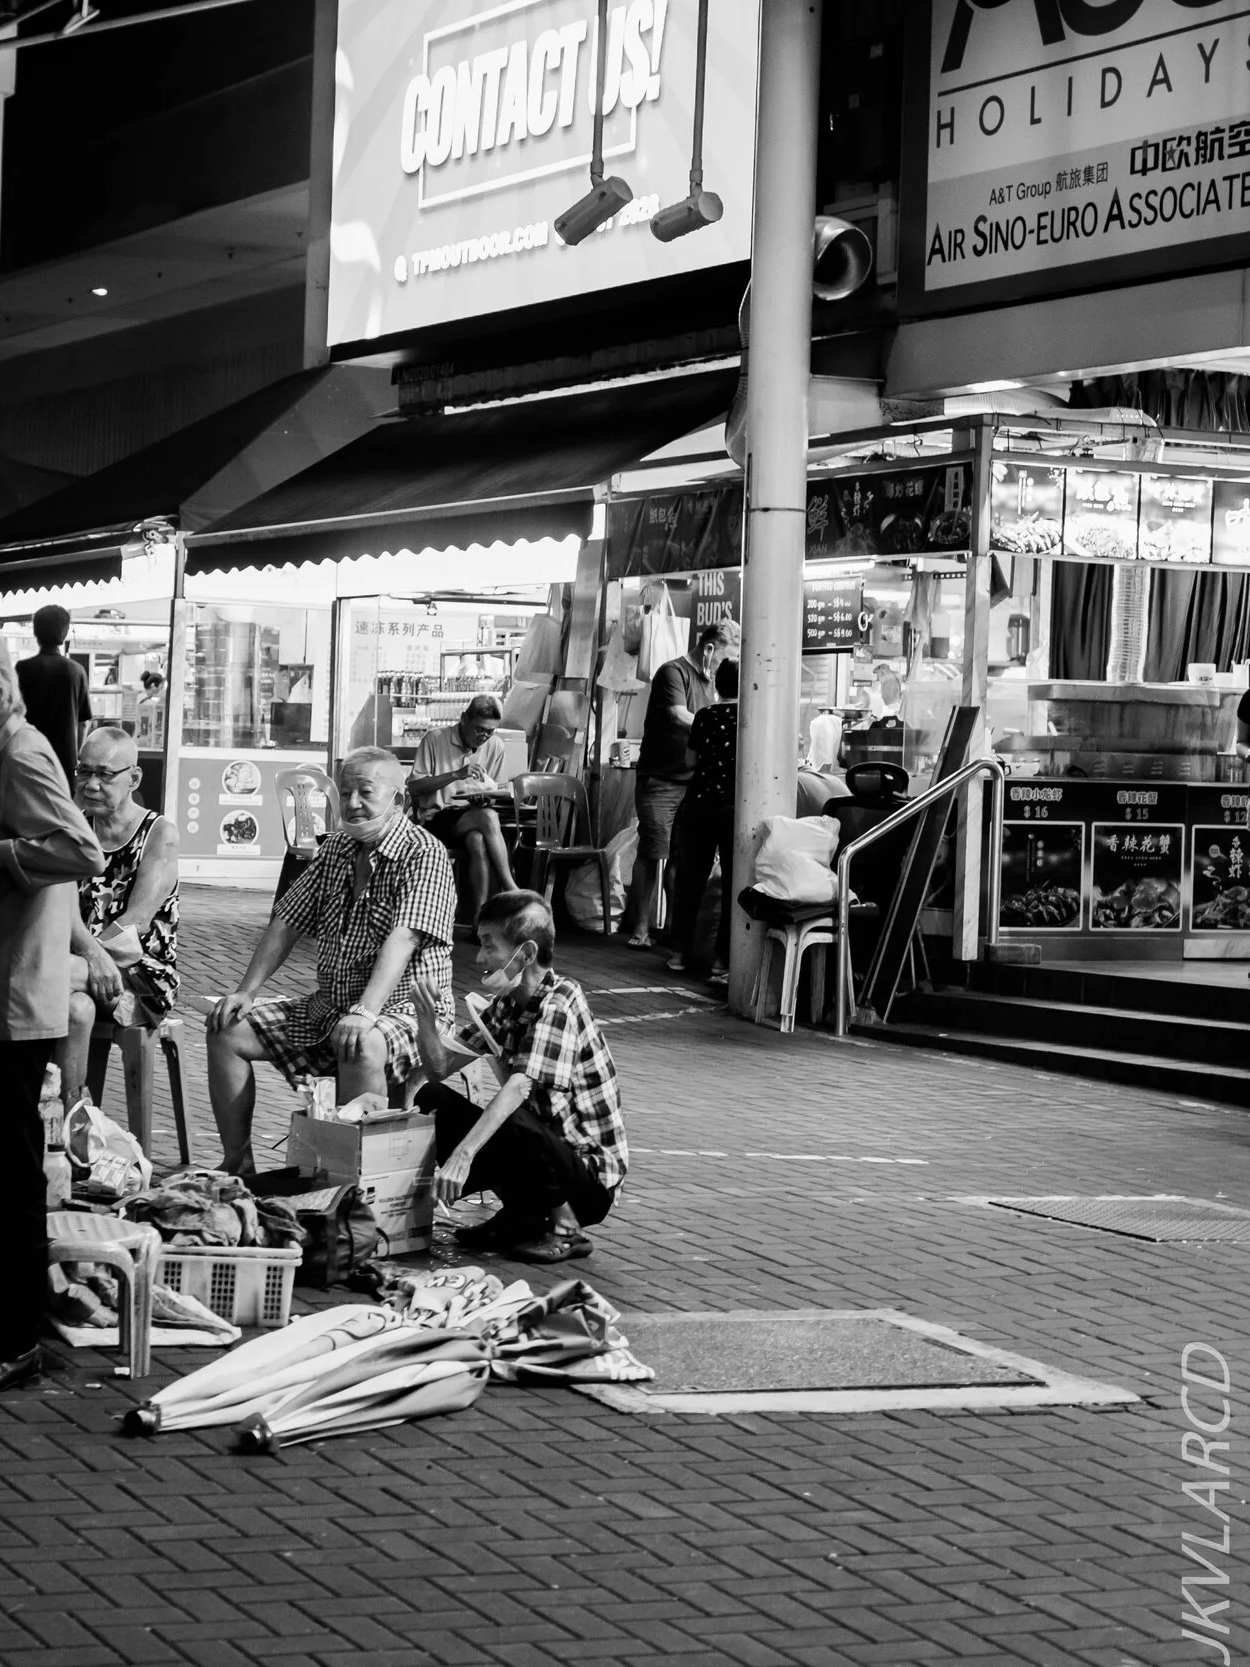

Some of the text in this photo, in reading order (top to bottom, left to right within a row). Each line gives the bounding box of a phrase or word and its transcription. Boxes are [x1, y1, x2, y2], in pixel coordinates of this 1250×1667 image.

[400, 0, 669, 175] CONTACT US!
[1129, 121, 1250, 177] 中欧航空
[989, 162, 1109, 206] A&T Group 航旅集团
[927, 222, 966, 266] AIR
[972, 201, 1098, 258] SINO-EURO
[697, 571, 725, 597] THIS
[696, 600, 733, 626] BUD'S
[355, 621, 444, 638] 速冻系列产品
[1034, 805, 1049, 818] 16
[1136, 807, 1149, 820] 15
[1106, 834, 1171, 855] 香辣花蟹
